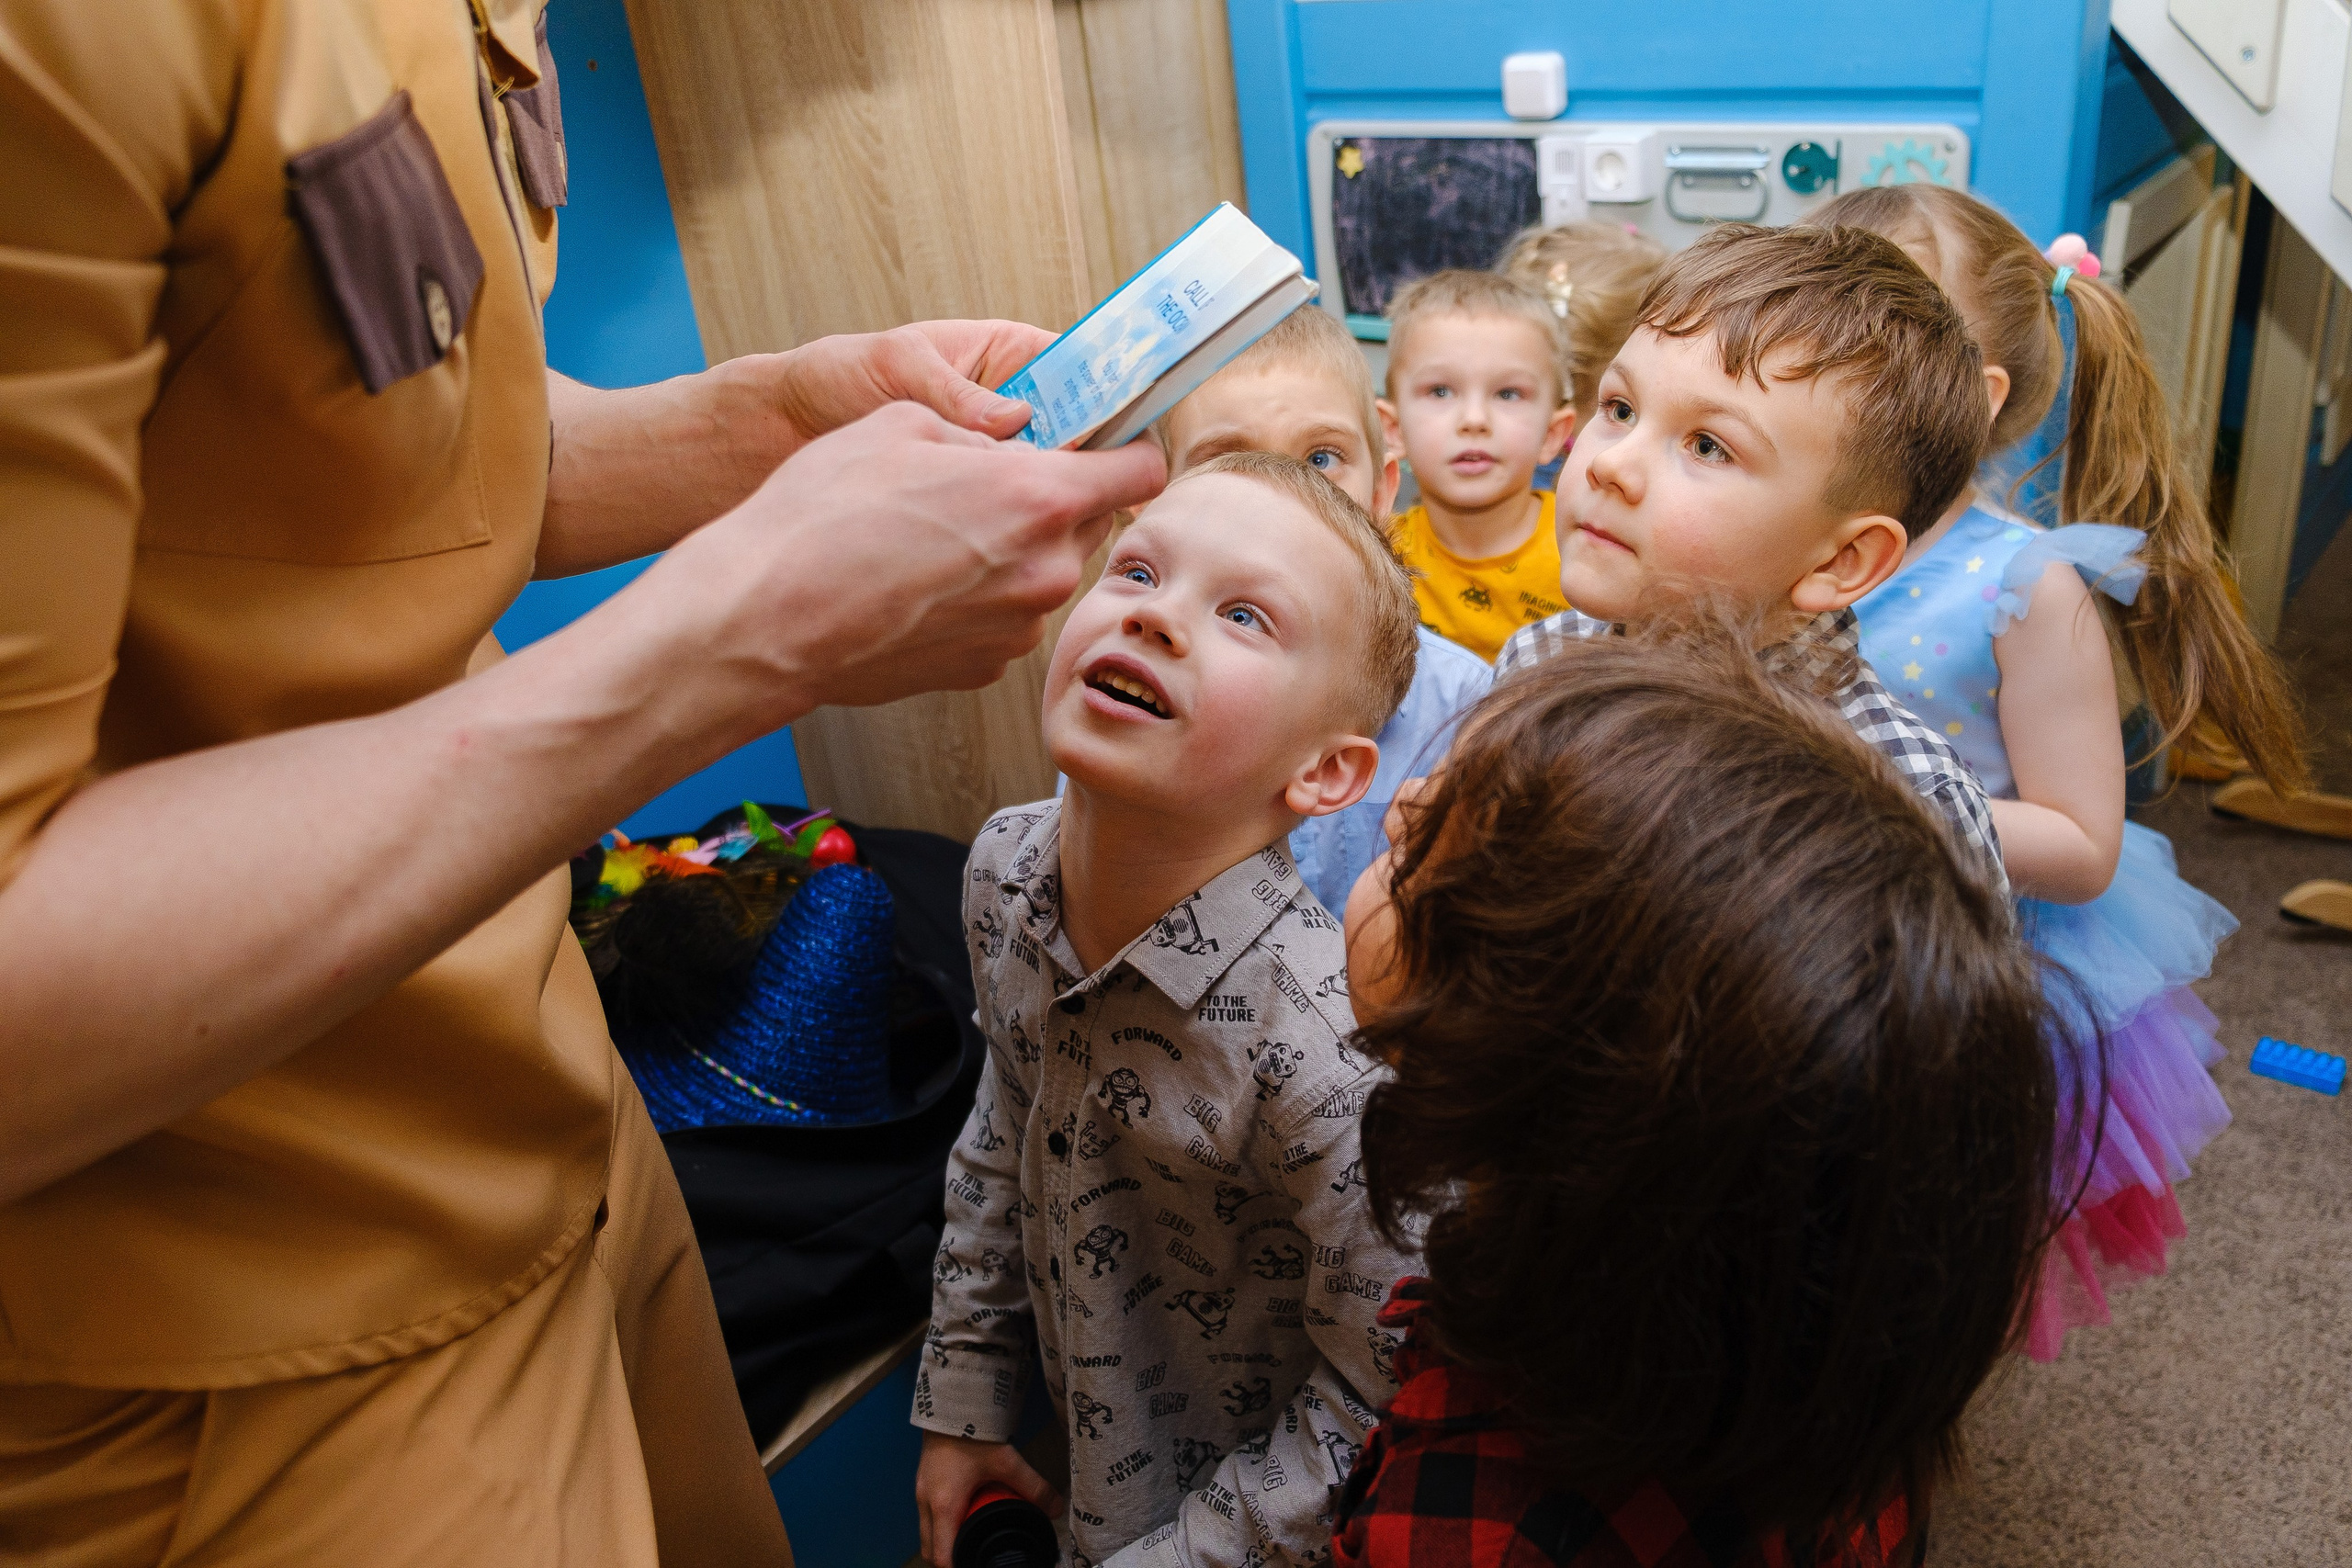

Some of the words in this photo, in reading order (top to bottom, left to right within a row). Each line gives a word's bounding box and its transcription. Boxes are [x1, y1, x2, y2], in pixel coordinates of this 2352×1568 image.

[1156, 293, 1179, 318] THE
[1183, 279, 1209, 308] CALL
[1259, 846, 1293, 882] GAM
[1198, 1007, 1256, 1023] FUTURE
[1206, 995, 1220, 1008] TO
[1222, 995, 1248, 1008] THE
[1111, 1026, 1183, 1062] FORWARD
[1183, 1093, 1222, 1134] BIG
[1184, 1134, 1241, 1178] GAME
[947, 1178, 989, 1209] FUTURE
[1070, 1177, 1142, 1213] FORWARD
[1156, 1208, 1196, 1237] BIG
[1166, 1237, 1216, 1277] GAME
[1123, 1275, 1165, 1317] FUTURE
[1325, 1272, 1383, 1303] GAME
[965, 1308, 1019, 1329] FORWA
[1266, 1297, 1300, 1314] BIG
[1135, 1361, 1167, 1393] BIG
[921, 1368, 935, 1418] FUTURE
[1148, 1393, 1190, 1420] GAME
[1106, 1451, 1155, 1486] FUTURE
[1108, 1461, 1125, 1474] TO
[1124, 1449, 1145, 1466] THE
[1216, 1485, 1238, 1505] THE
